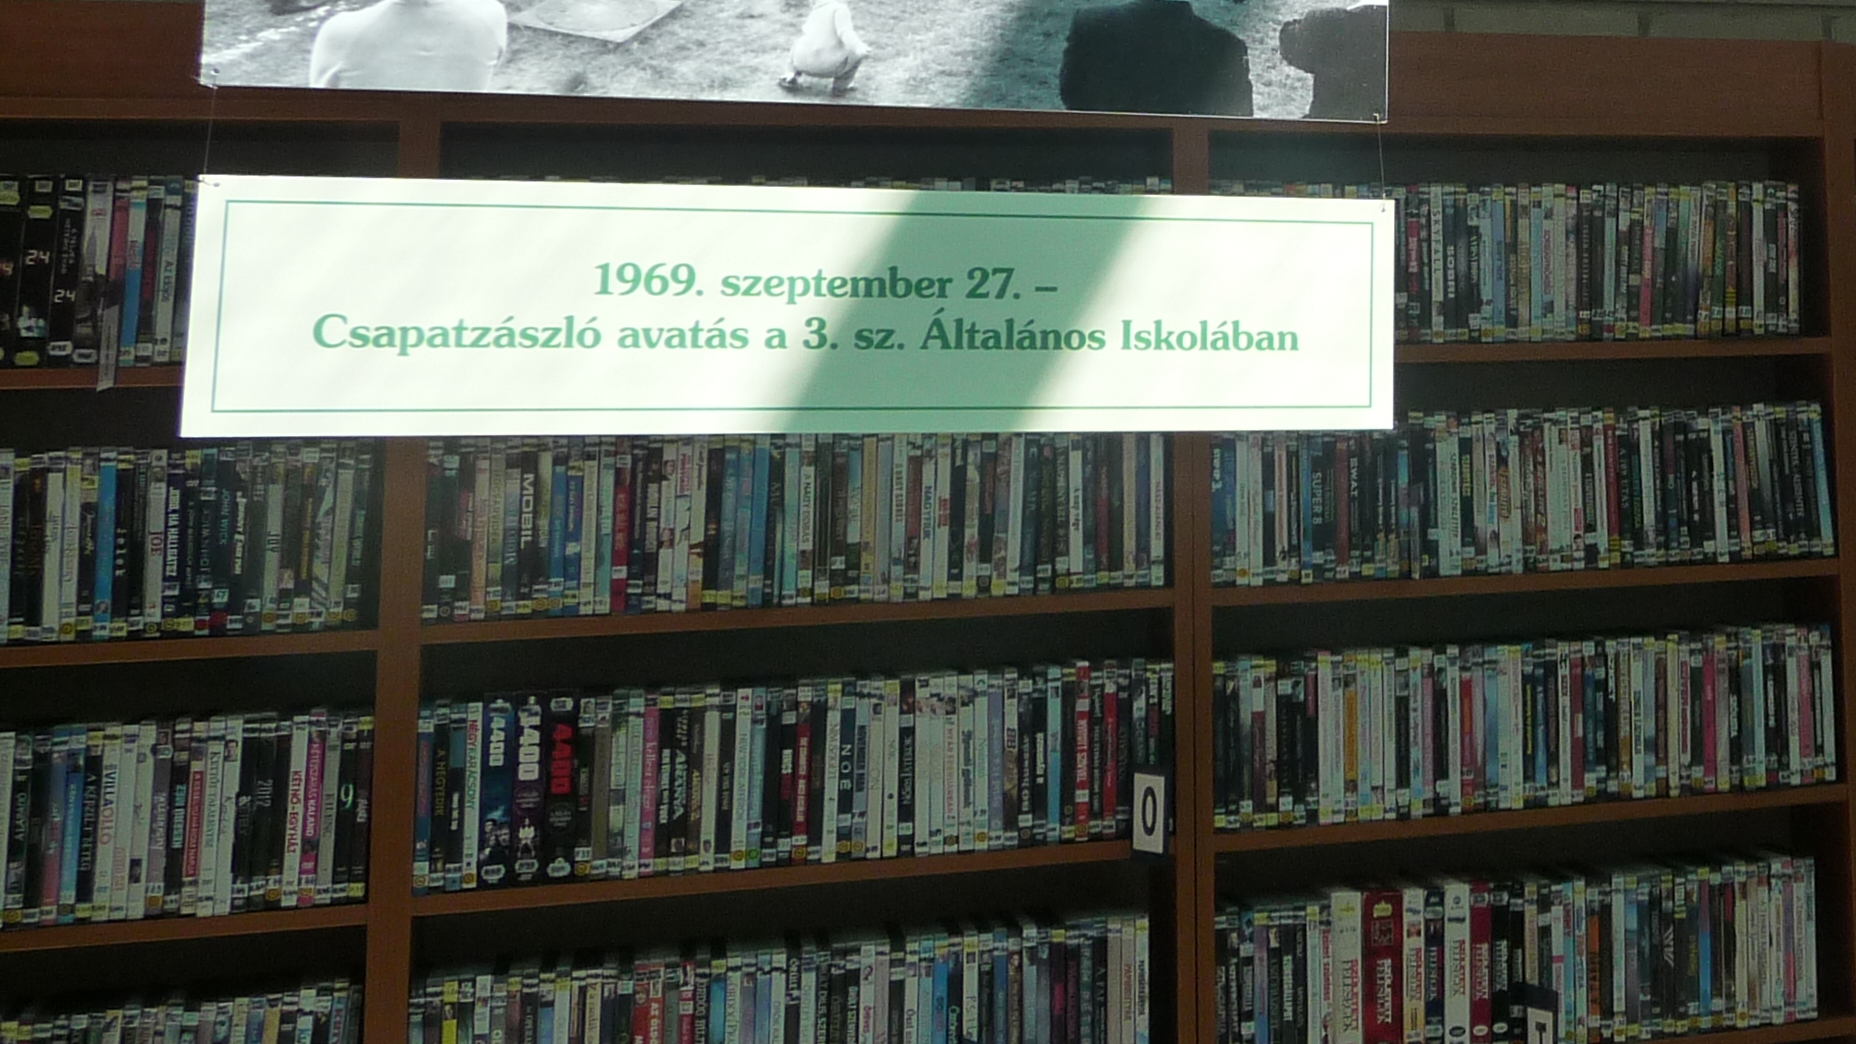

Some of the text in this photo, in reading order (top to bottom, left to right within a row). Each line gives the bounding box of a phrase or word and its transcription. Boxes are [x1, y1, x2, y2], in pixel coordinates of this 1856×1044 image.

[1432, 210, 1441, 274] SKYFALL
[594, 261, 704, 297] 1969.
[720, 265, 954, 306] szeptember
[965, 266, 1021, 301] 27.
[313, 307, 1300, 357] Csapatzászló avatás a 3. sz. Általános Iskolában
[219, 488, 231, 546] JOHN WICK
[520, 473, 535, 550] MOBIL
[1311, 472, 1323, 513] SUPER
[151, 531, 163, 556] JOE
[489, 716, 506, 767] 4400
[550, 723, 574, 795] 4400
[256, 779, 274, 807] 2012
[306, 798, 317, 837] KALAND
[341, 783, 355, 810] 9
[1141, 786, 1158, 837] O
